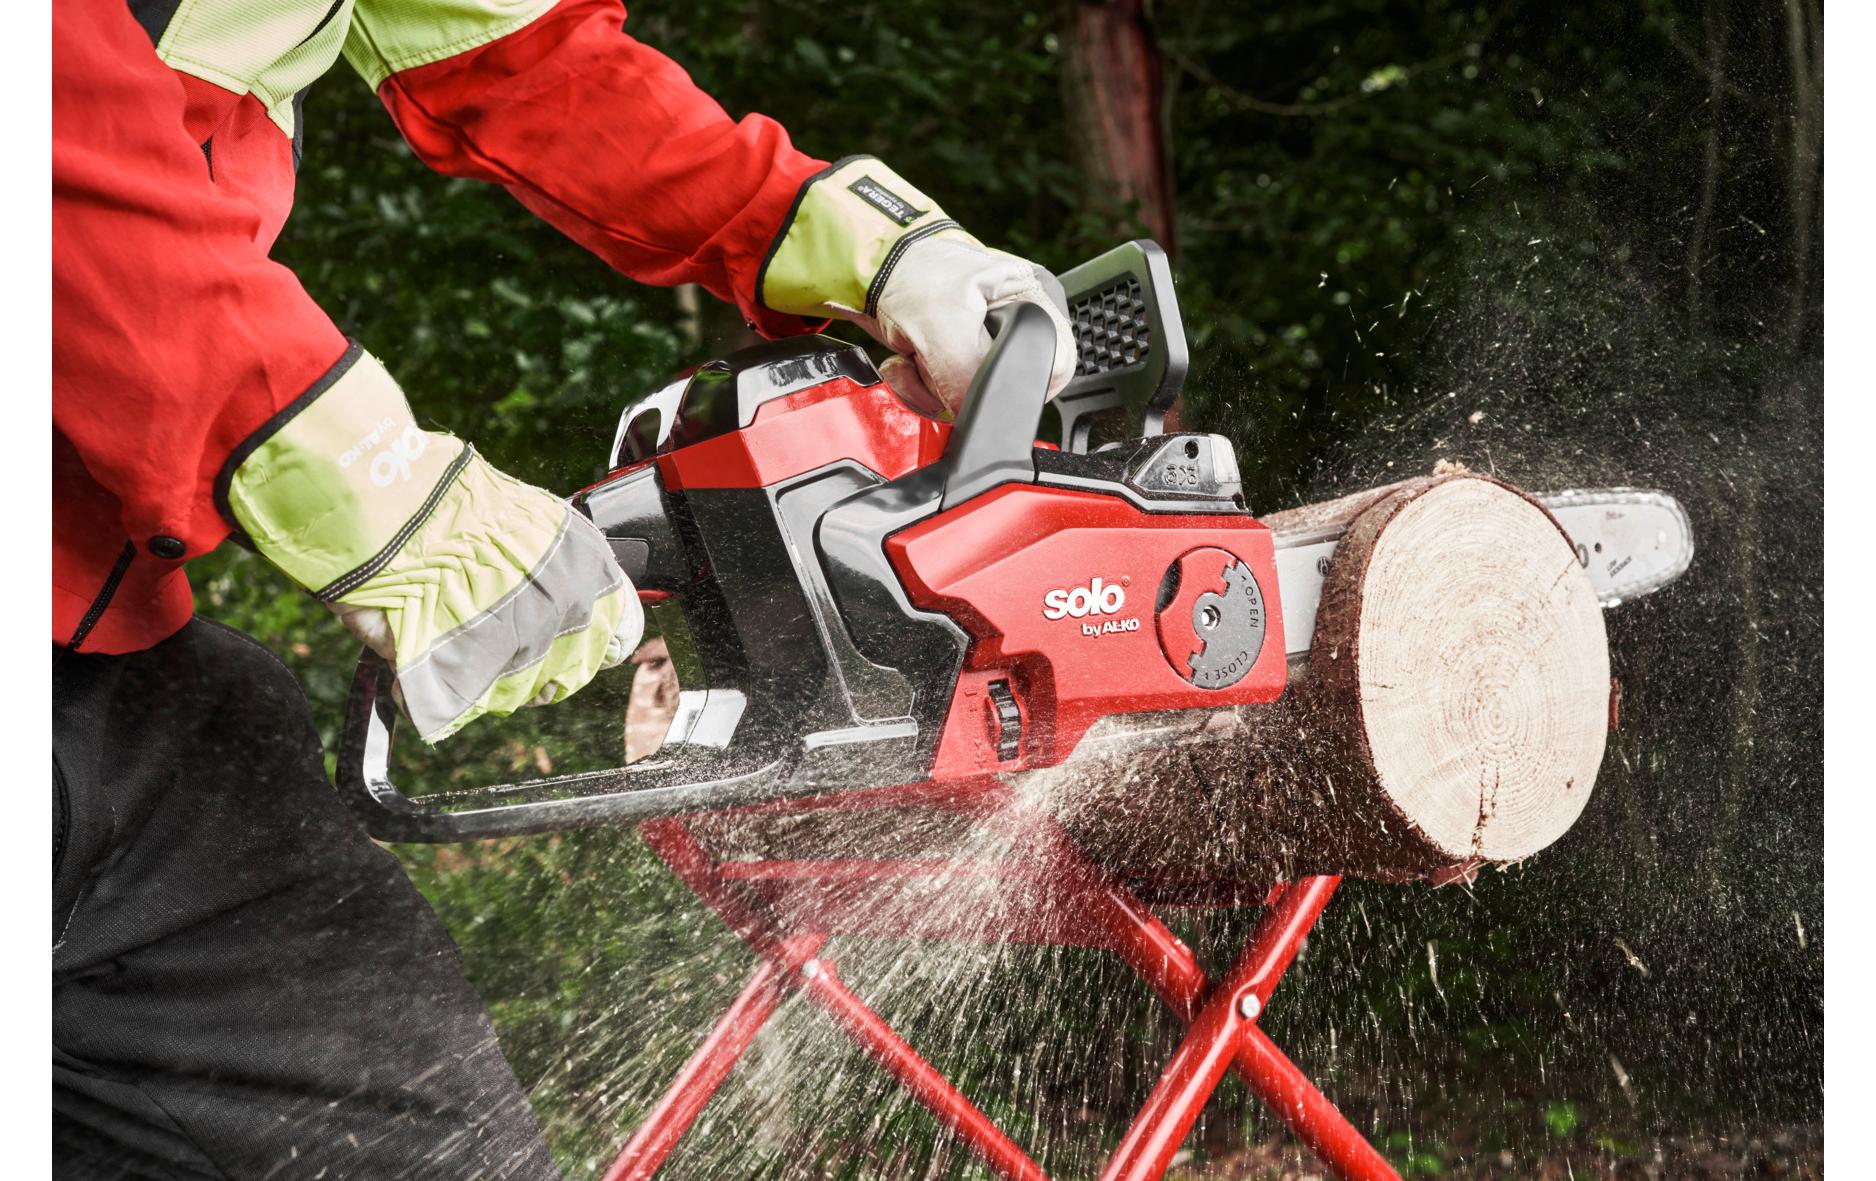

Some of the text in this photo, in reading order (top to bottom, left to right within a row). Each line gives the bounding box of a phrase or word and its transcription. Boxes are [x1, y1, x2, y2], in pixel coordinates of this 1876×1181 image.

[1042, 577, 1125, 620] solo
[1244, 586, 1258, 628] OPEN
[1082, 623, 1101, 637] by
[1215, 651, 1248, 680] CLOSE
